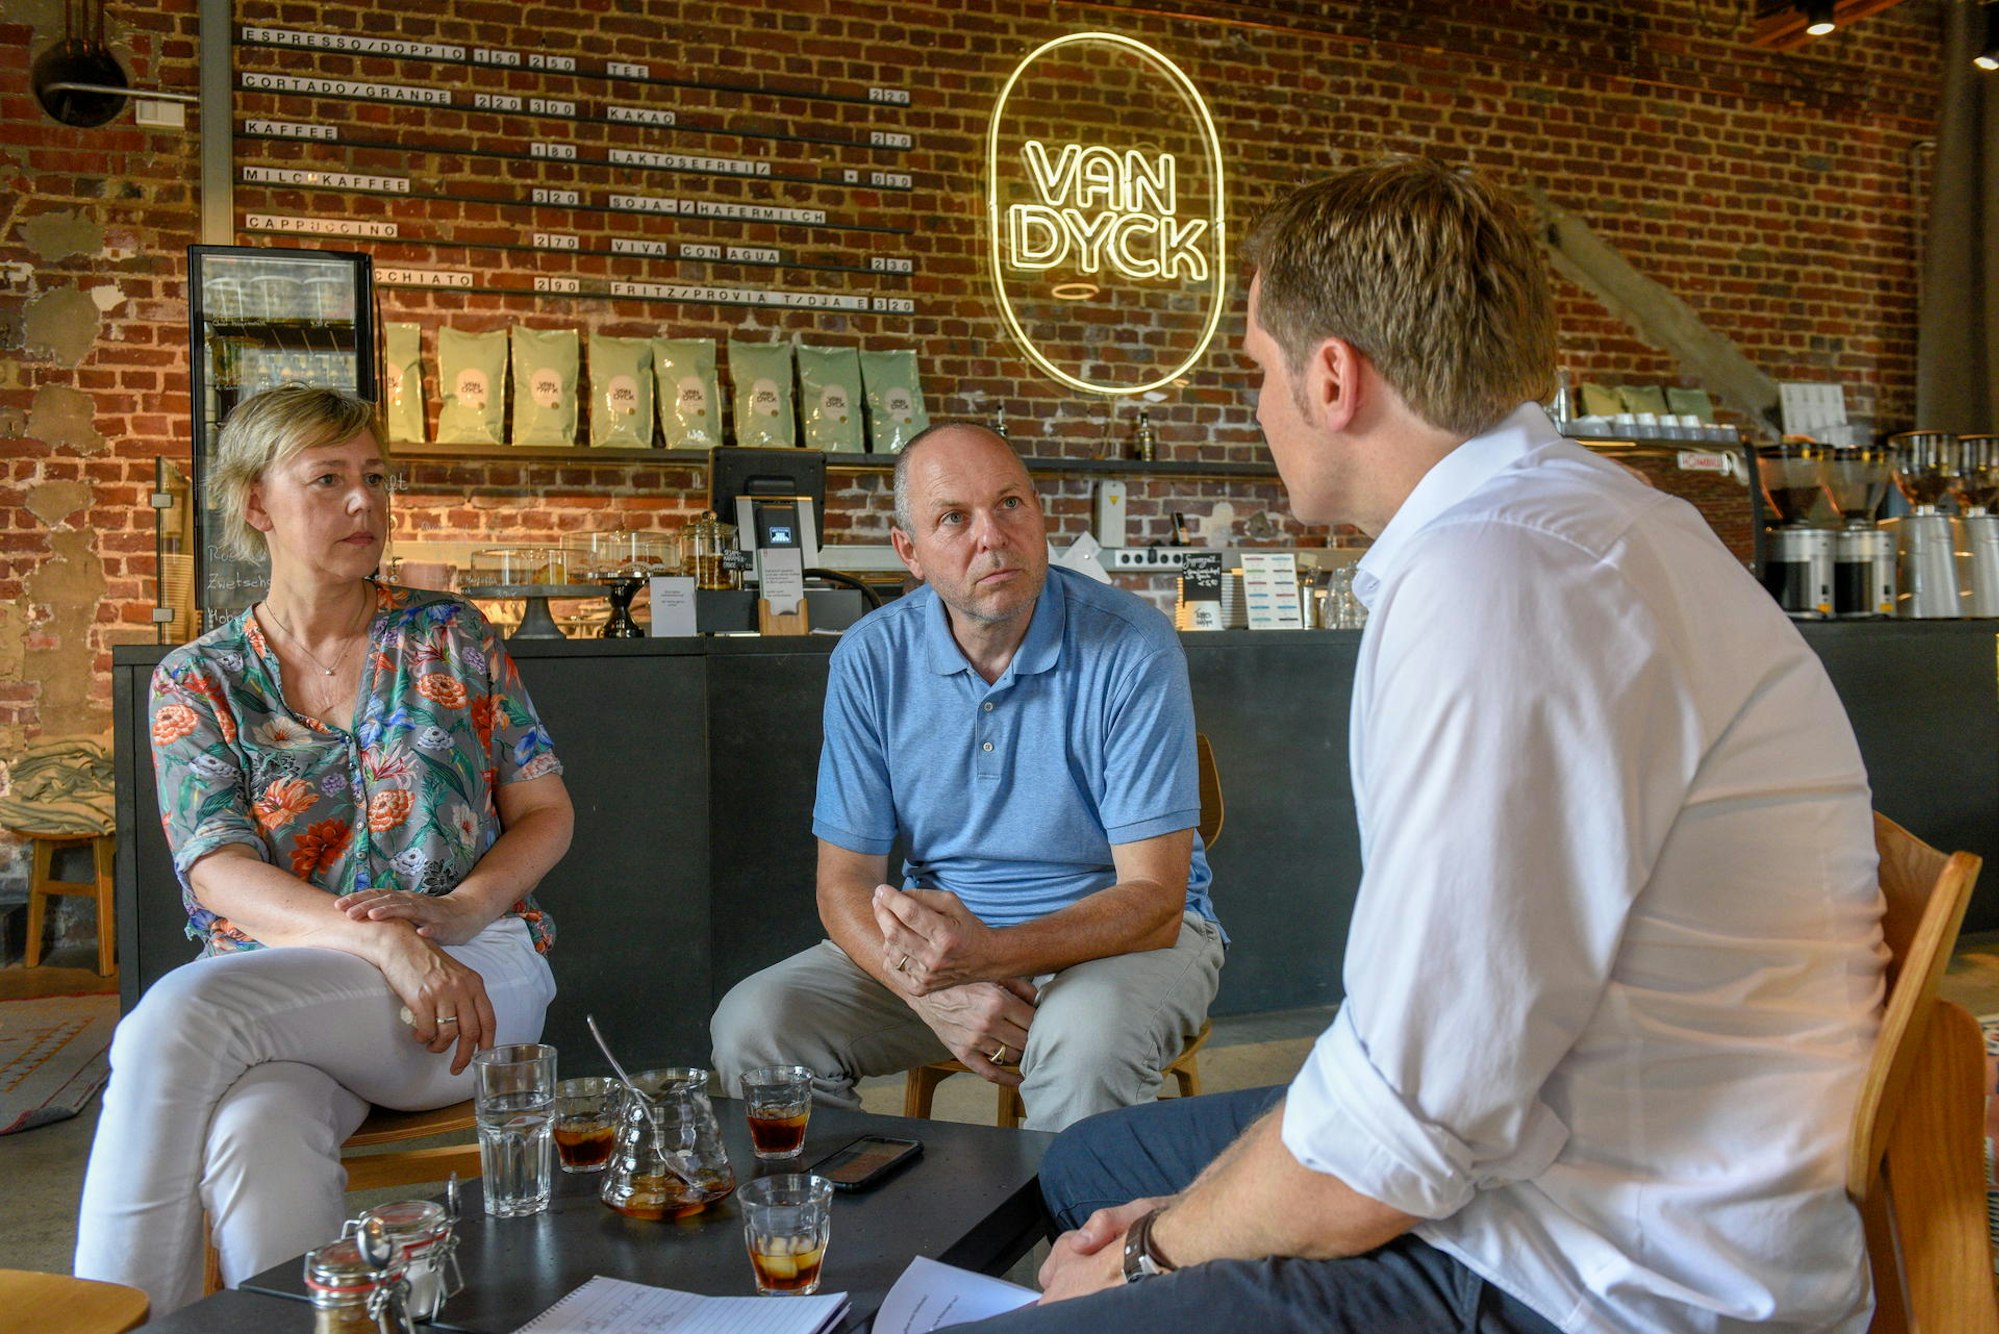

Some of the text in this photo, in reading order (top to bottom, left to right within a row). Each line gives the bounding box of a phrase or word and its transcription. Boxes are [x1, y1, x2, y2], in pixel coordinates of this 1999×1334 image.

[244, 30, 462, 60] ESPRESSO/DOPPIO
[611, 65, 645, 78] TEE
[244, 75, 448, 103] CORTADO/GRANDE
[610, 109, 673, 124] KAKAO
[247, 122, 335, 140] KAFFEE
[1022, 140, 1176, 216] VAN
[248, 216, 395, 237] CAPPUCCINO
[614, 241, 664, 254] VIVA
[682, 246, 719, 258] CON
[729, 248, 778, 262] AGUA
[1008, 203, 1209, 281] DYCK
